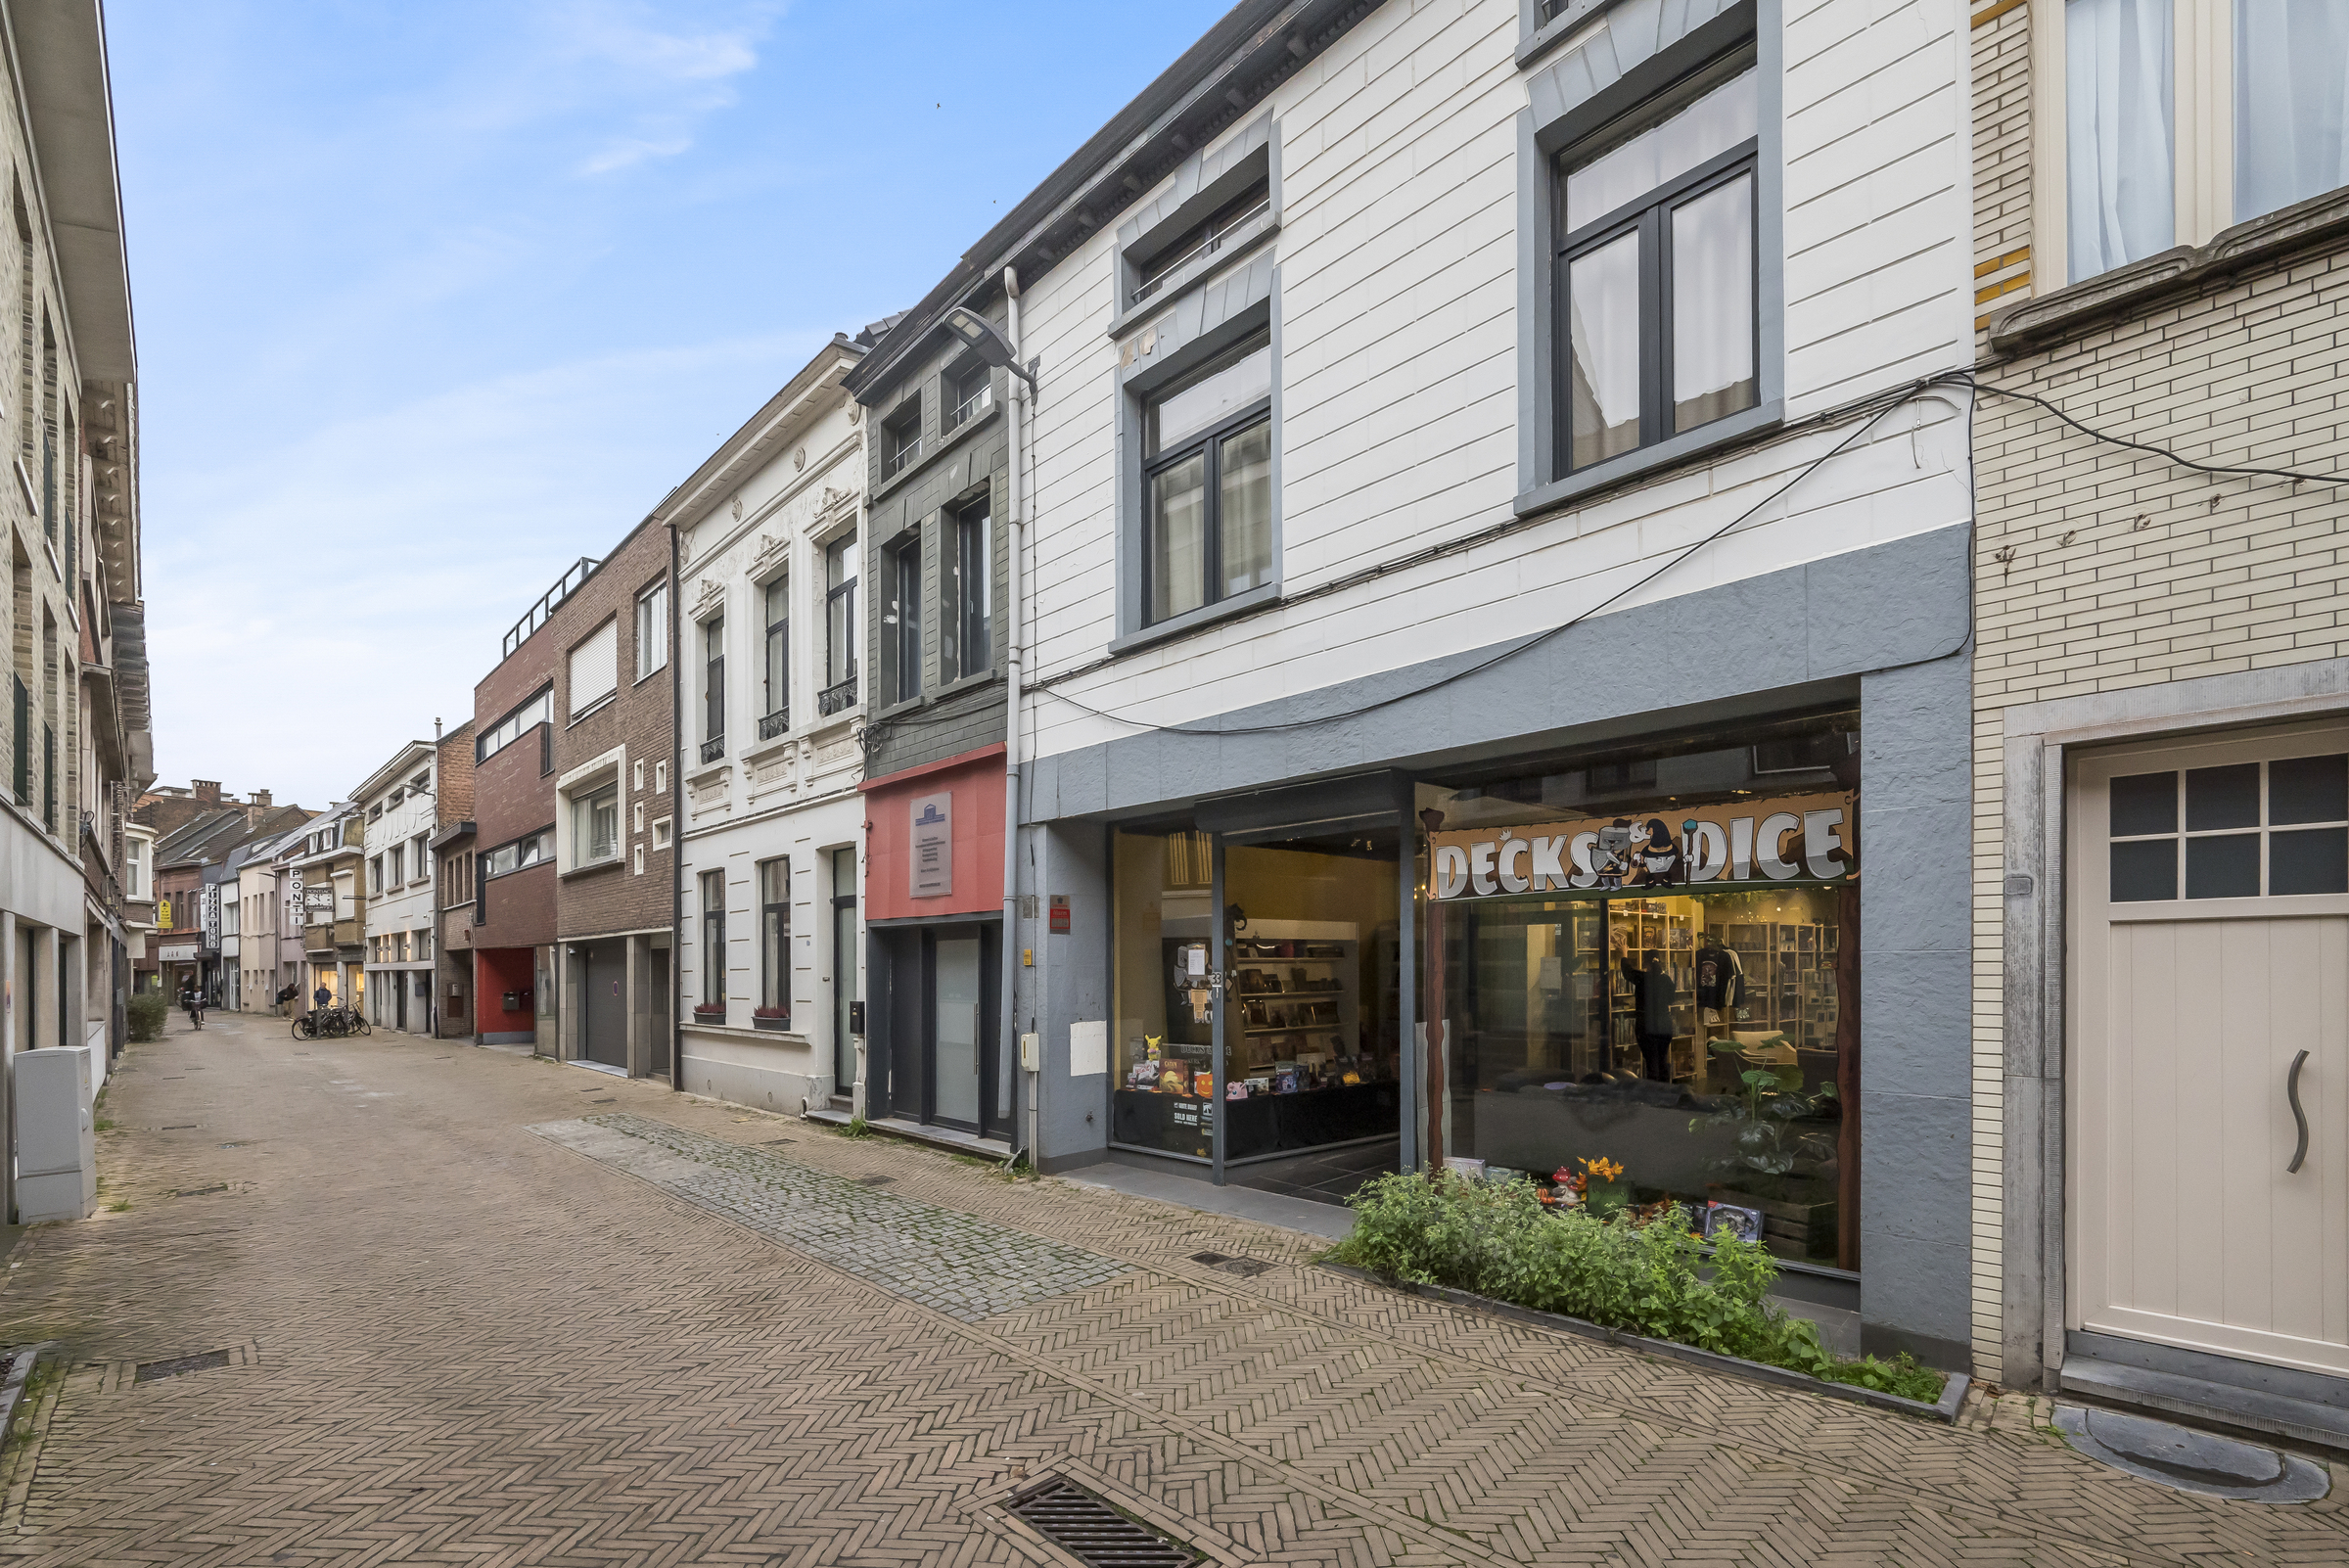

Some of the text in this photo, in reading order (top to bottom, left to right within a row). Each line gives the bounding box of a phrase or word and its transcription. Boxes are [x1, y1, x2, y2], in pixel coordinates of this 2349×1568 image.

[1436, 831, 1599, 898] DECKS
[1681, 808, 1847, 882] DICE
[292, 870, 301, 924] PONTI
[1212, 973, 1221, 984] 33
[1185, 1114, 1198, 1123] HERE
